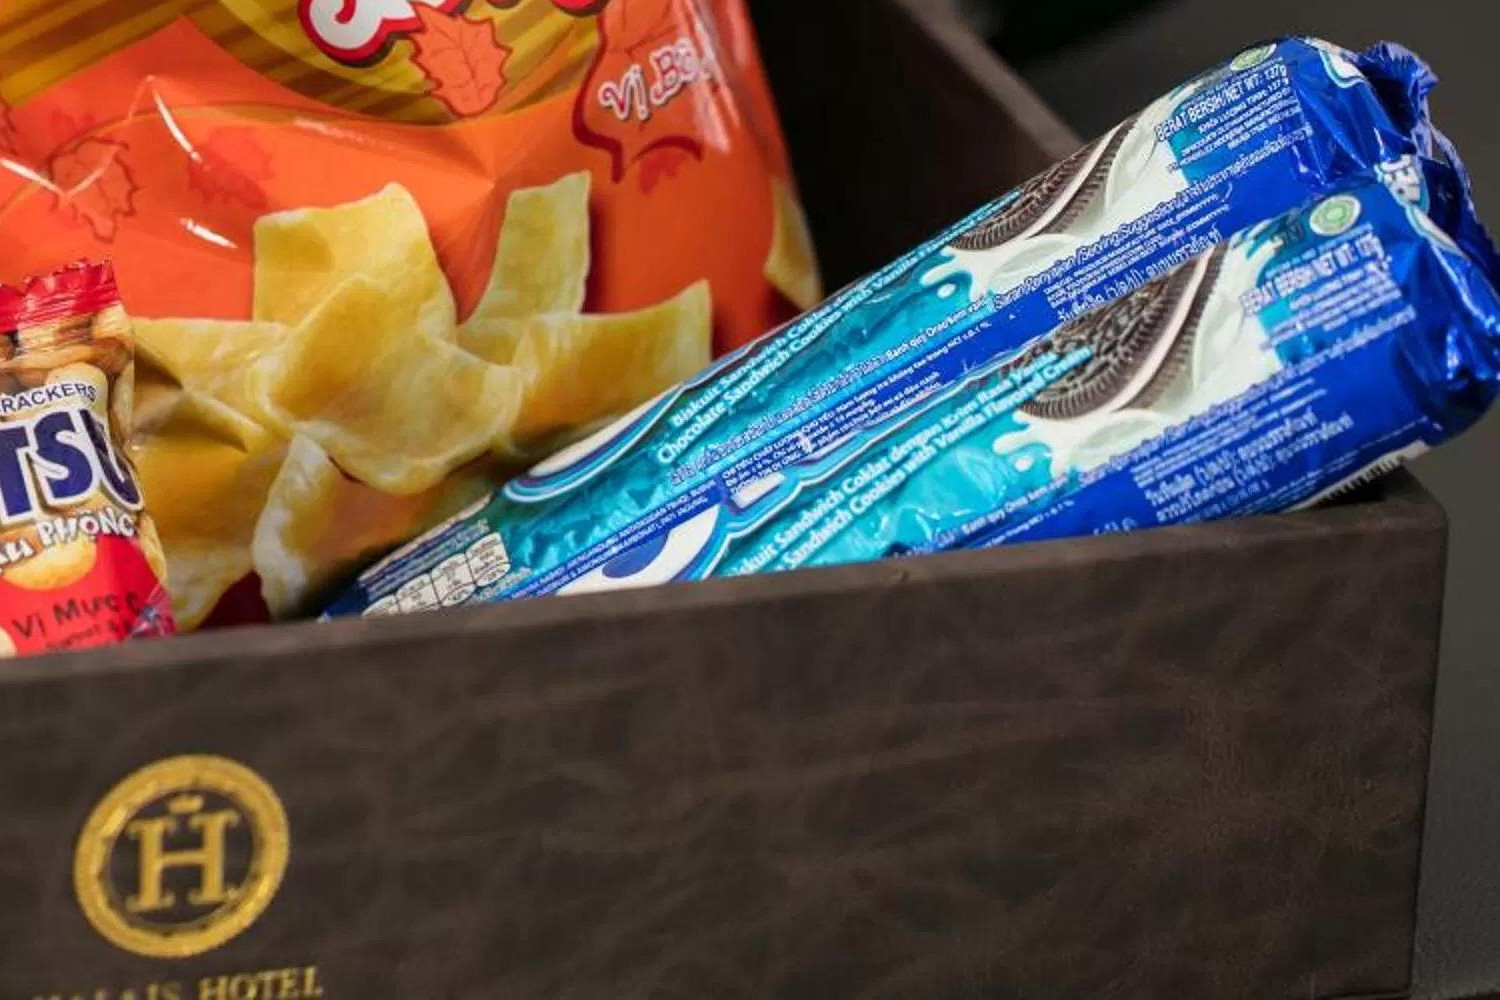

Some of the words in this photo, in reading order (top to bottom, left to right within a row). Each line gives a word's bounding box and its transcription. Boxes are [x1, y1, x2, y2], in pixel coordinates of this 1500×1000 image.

[1153, 111, 1191, 142] BERAT
[1263, 62, 1288, 81] 137g
[654, 394, 729, 466] Chocolate
[721, 346, 791, 407] Sandwich
[787, 307, 843, 354] Cookies
[671, 382, 722, 428] Biskuit
[717, 334, 787, 390] Sandwich
[772, 485, 845, 548] Sandwich
[839, 451, 892, 496] Coklat
[887, 420, 946, 463] dengan
[782, 505, 854, 570] Sandwich
[846, 462, 910, 515] Cookies
[902, 440, 937, 474] with
[932, 410, 987, 451] Vanilla
[197, 964, 324, 1000] HOTEL
